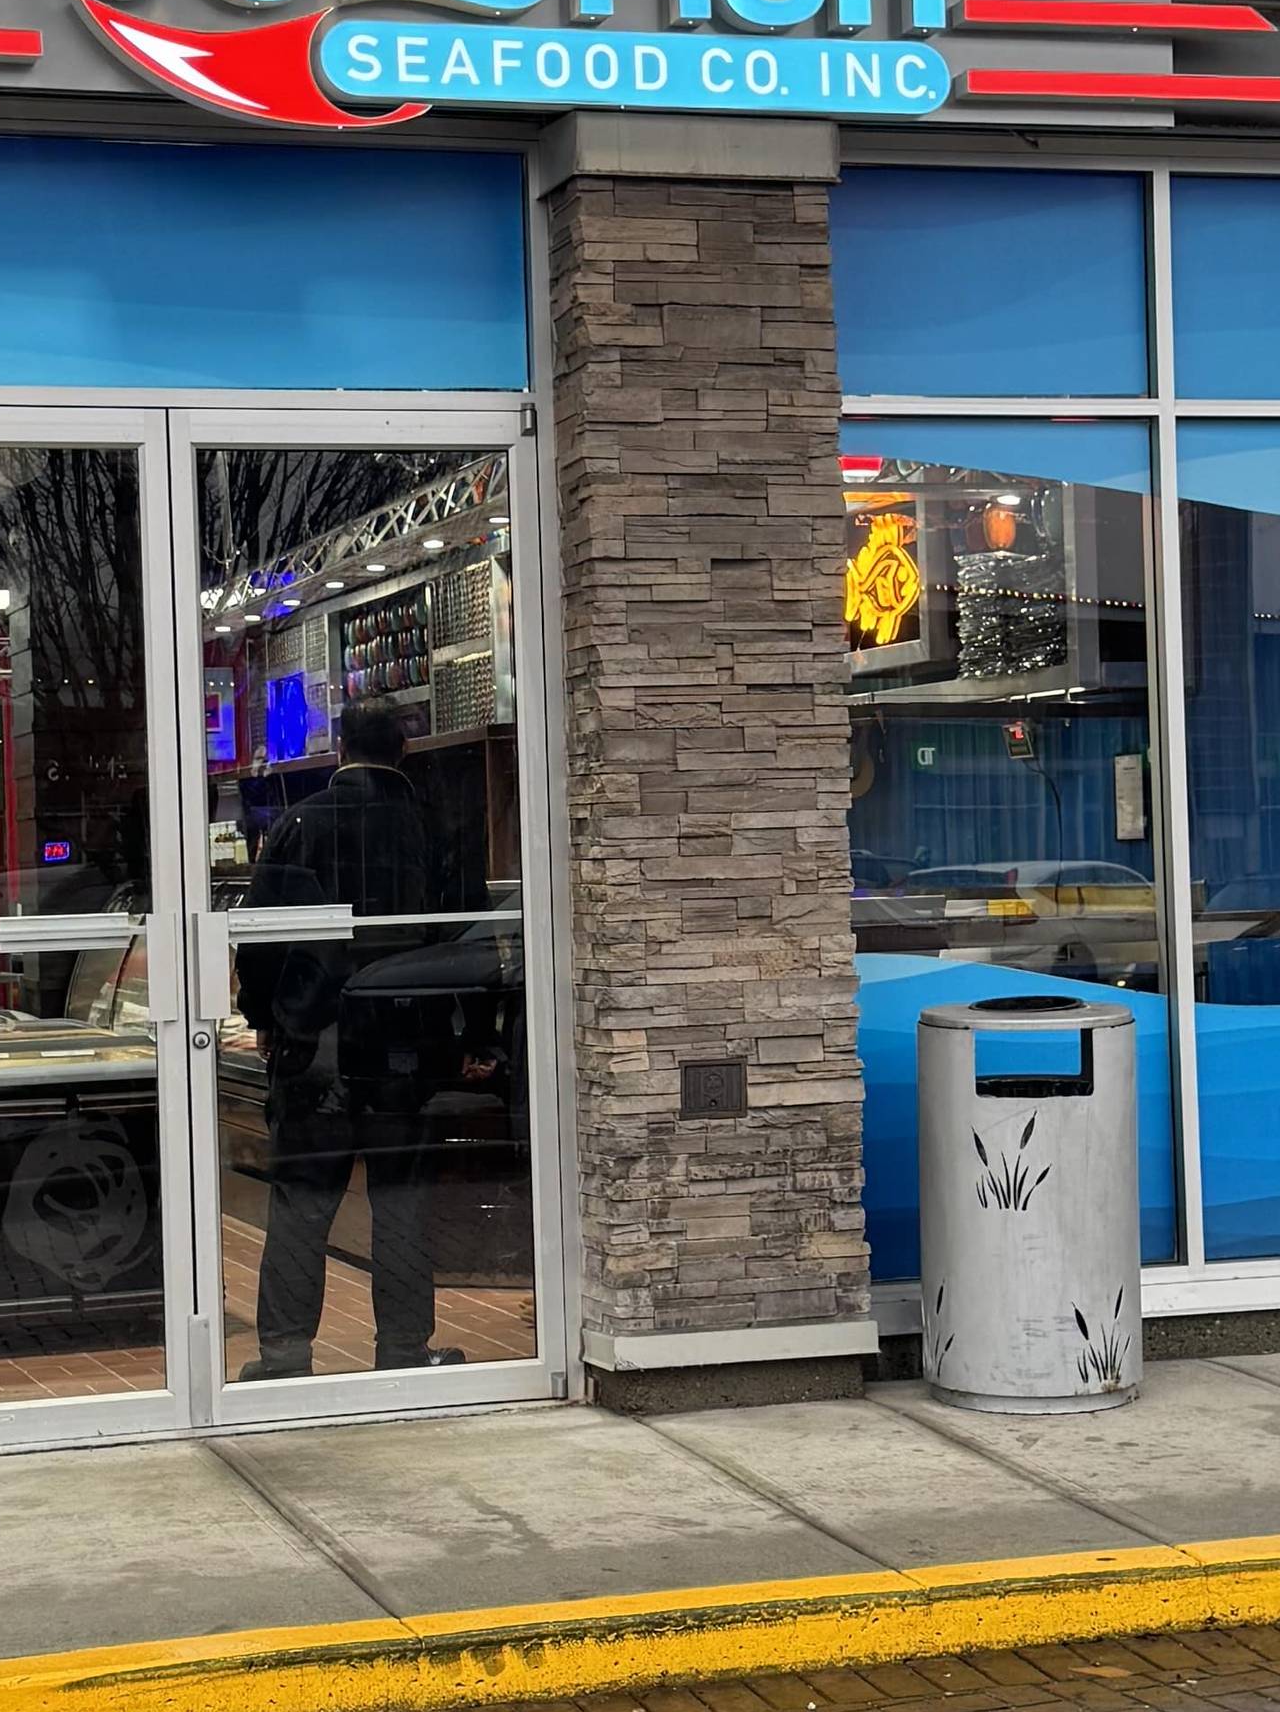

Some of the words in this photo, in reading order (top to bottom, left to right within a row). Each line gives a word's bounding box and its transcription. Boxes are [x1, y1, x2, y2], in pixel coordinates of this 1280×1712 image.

[346, 34, 669, 92] SEAFOOD
[700, 48, 790, 96] CO.
[819, 50, 938, 101] INC.
